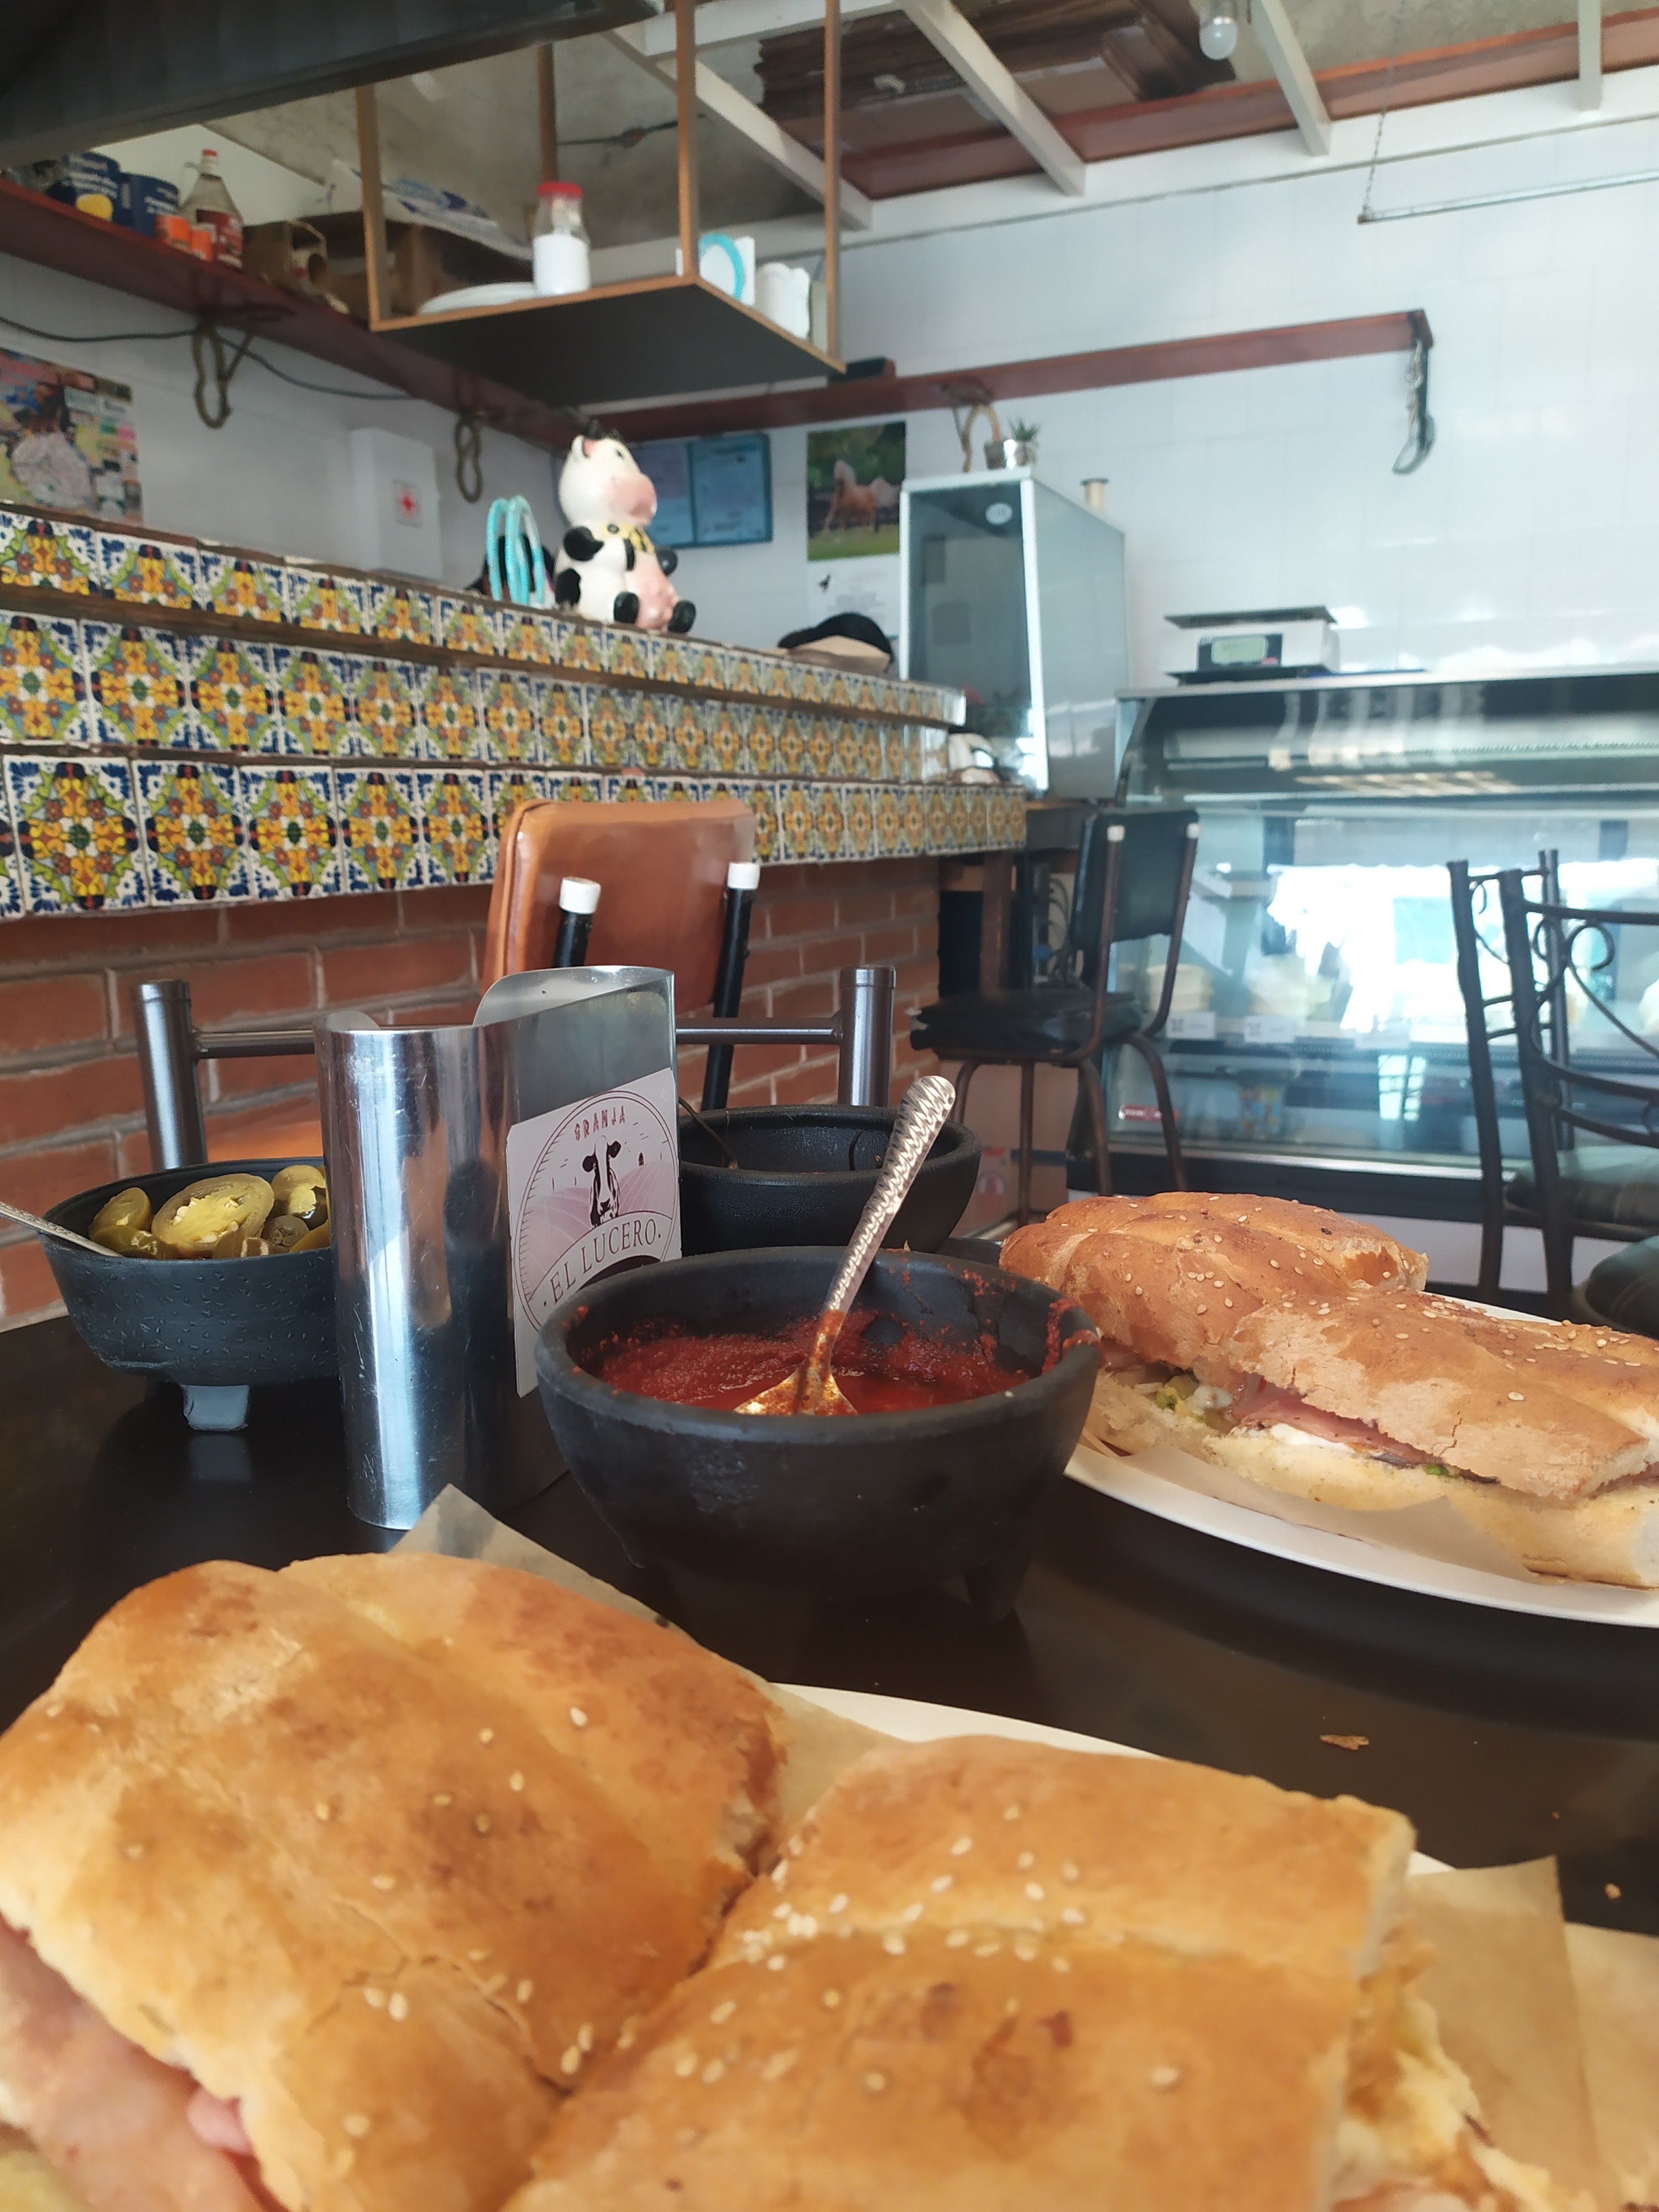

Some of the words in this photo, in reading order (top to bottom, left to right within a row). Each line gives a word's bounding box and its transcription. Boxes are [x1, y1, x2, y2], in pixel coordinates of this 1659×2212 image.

[574, 1105, 625, 1142] GRANJA
[550, 1261, 576, 1305] EL
[581, 1218, 656, 1275] LUCERO
